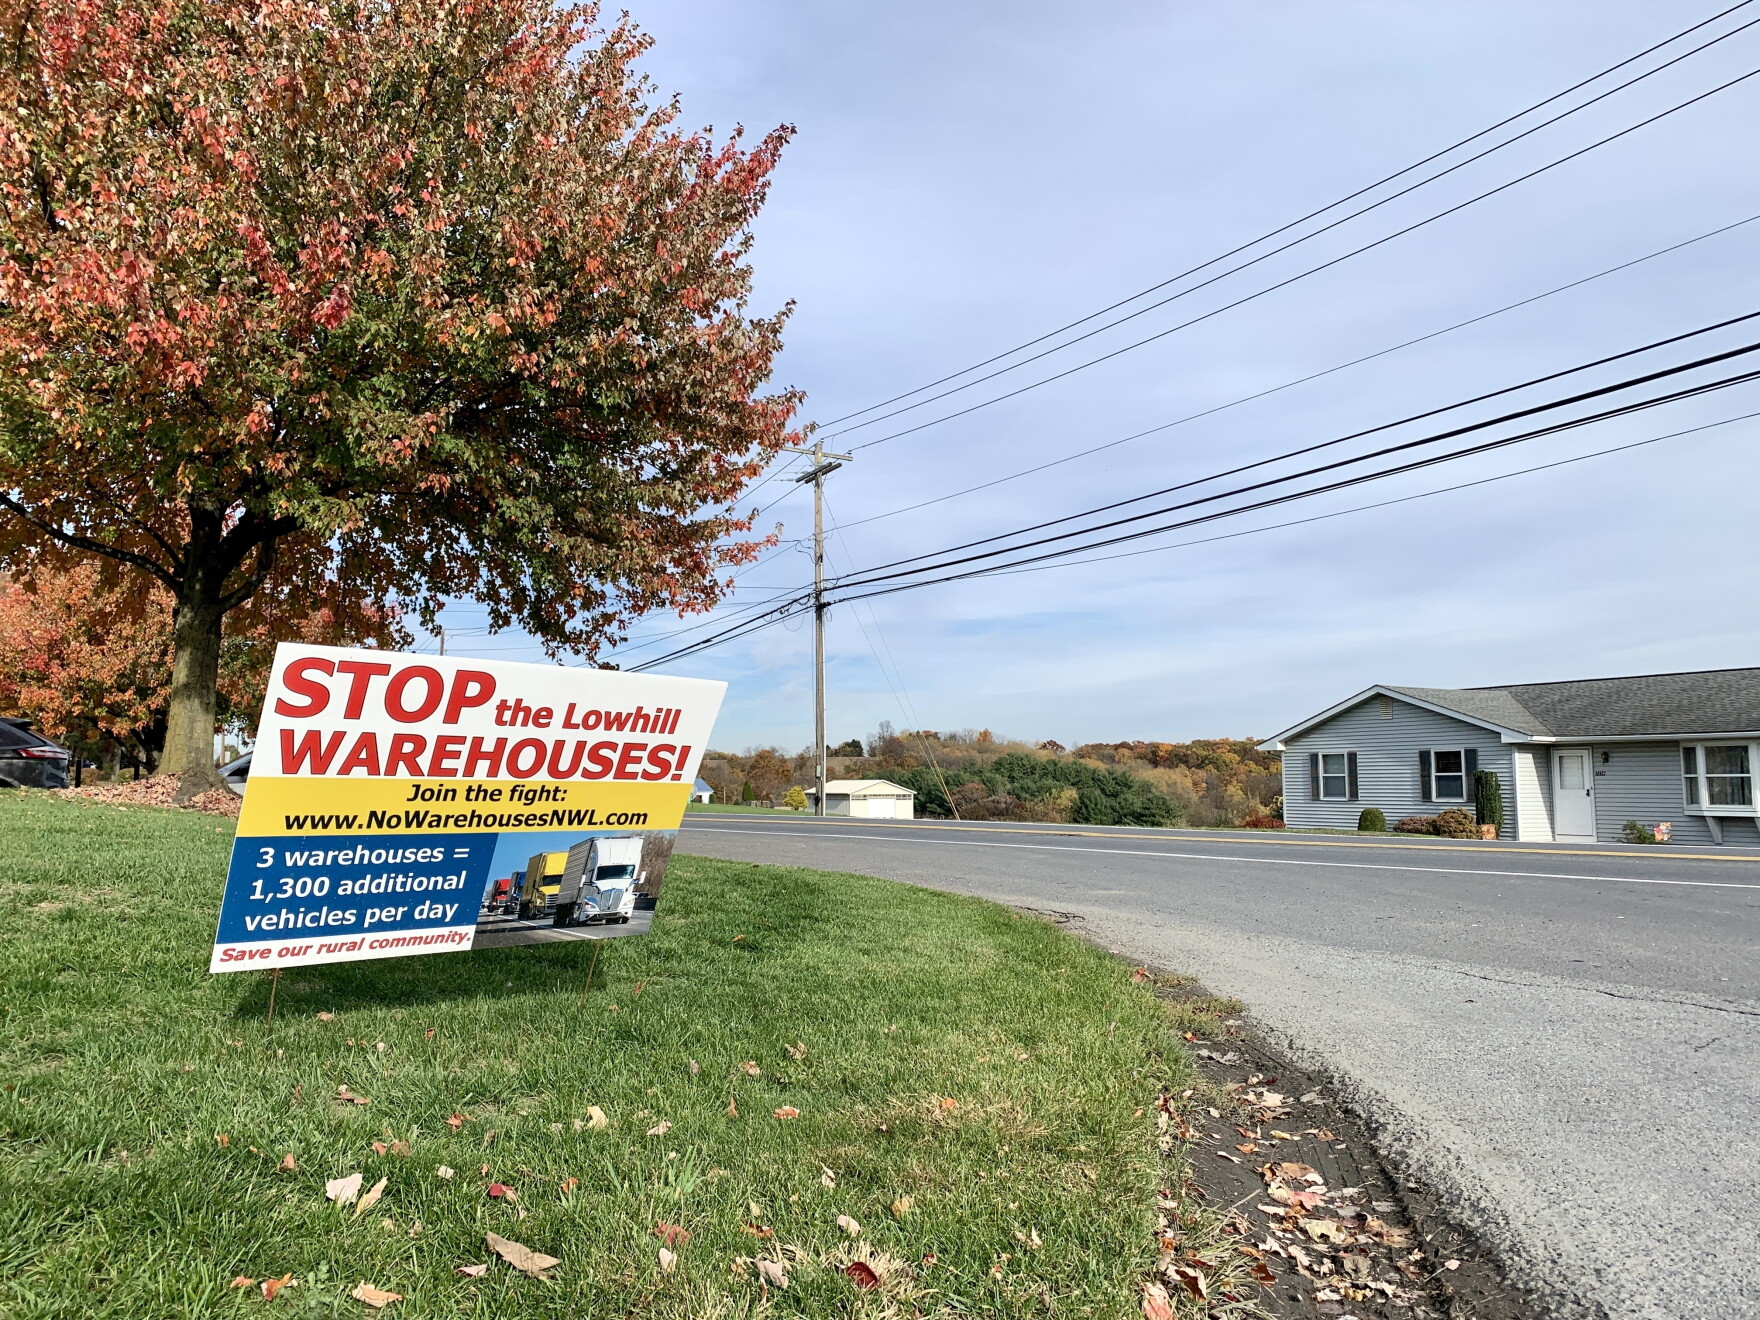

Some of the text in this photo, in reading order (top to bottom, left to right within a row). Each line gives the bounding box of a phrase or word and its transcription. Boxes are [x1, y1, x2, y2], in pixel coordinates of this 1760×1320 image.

[275, 657, 681, 734] STOP the Lowhill
[280, 729, 691, 781] WAREHOUSES!
[406, 784, 567, 806] Join the fight:
[285, 810, 648, 831] www.NoWarehousesNWL.com
[257, 845, 470, 868] 3 warehouses =
[249, 871, 467, 902] 1,300 additional
[244, 900, 458, 931] vehicles per day
[219, 929, 471, 963] Save our rural community.
